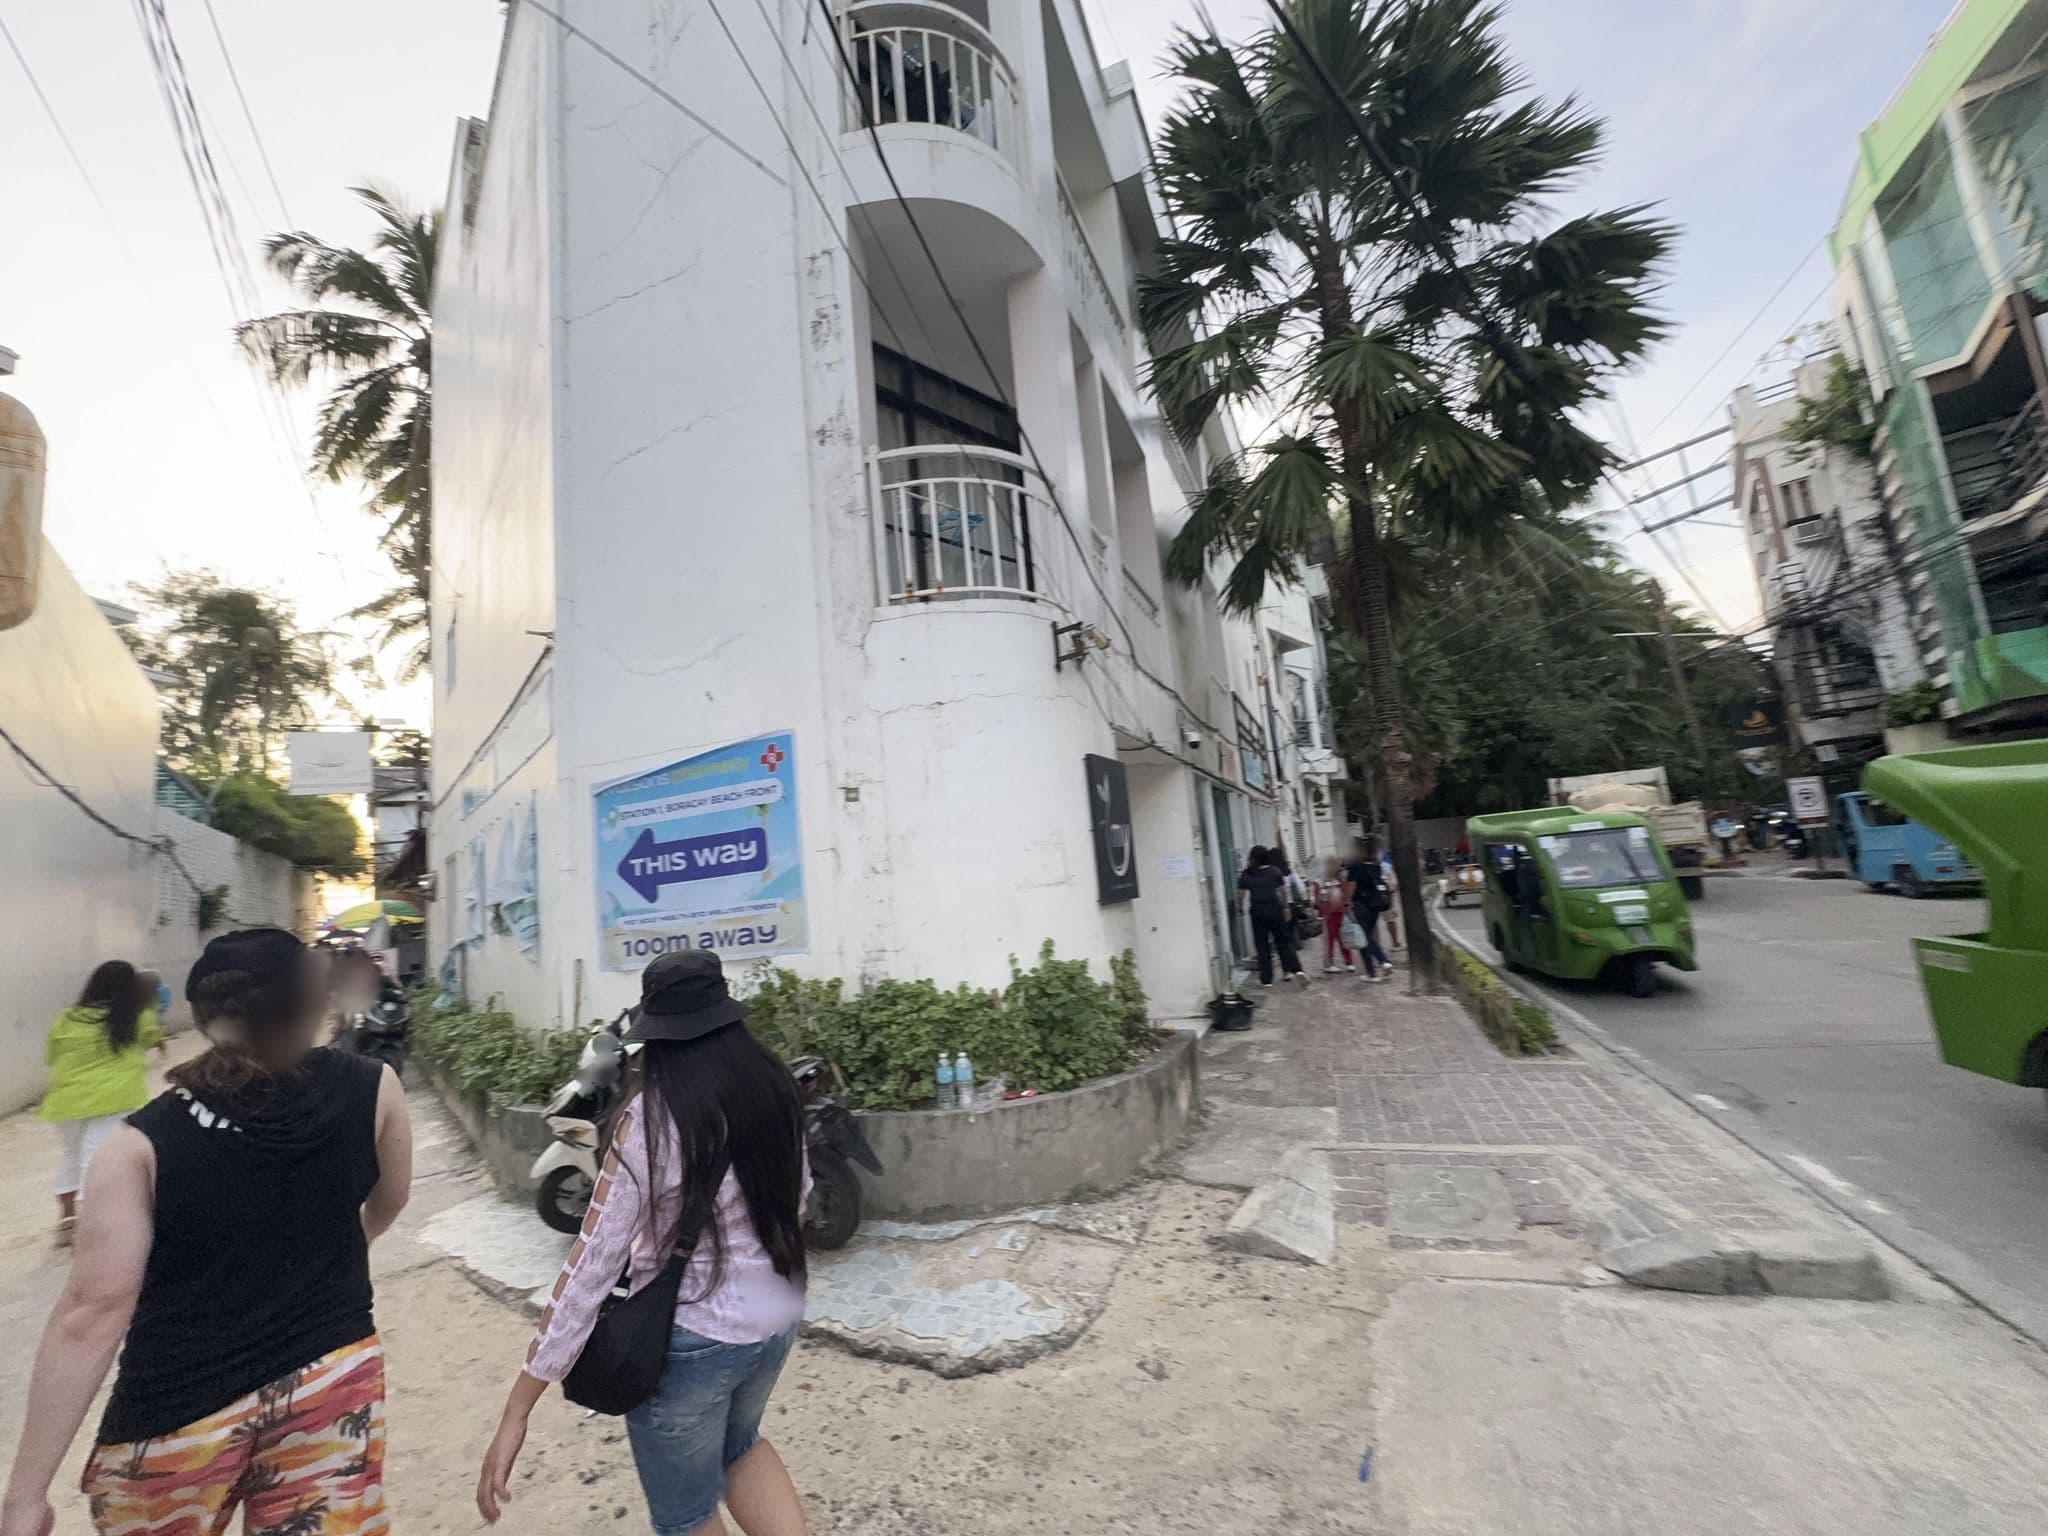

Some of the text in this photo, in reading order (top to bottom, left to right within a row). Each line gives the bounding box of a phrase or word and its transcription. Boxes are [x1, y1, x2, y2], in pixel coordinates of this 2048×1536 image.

[710, 792, 741, 805] BEACH
[744, 784, 778, 797] FRONT
[628, 851, 688, 876] THIS
[622, 924, 777, 957] 100m away
